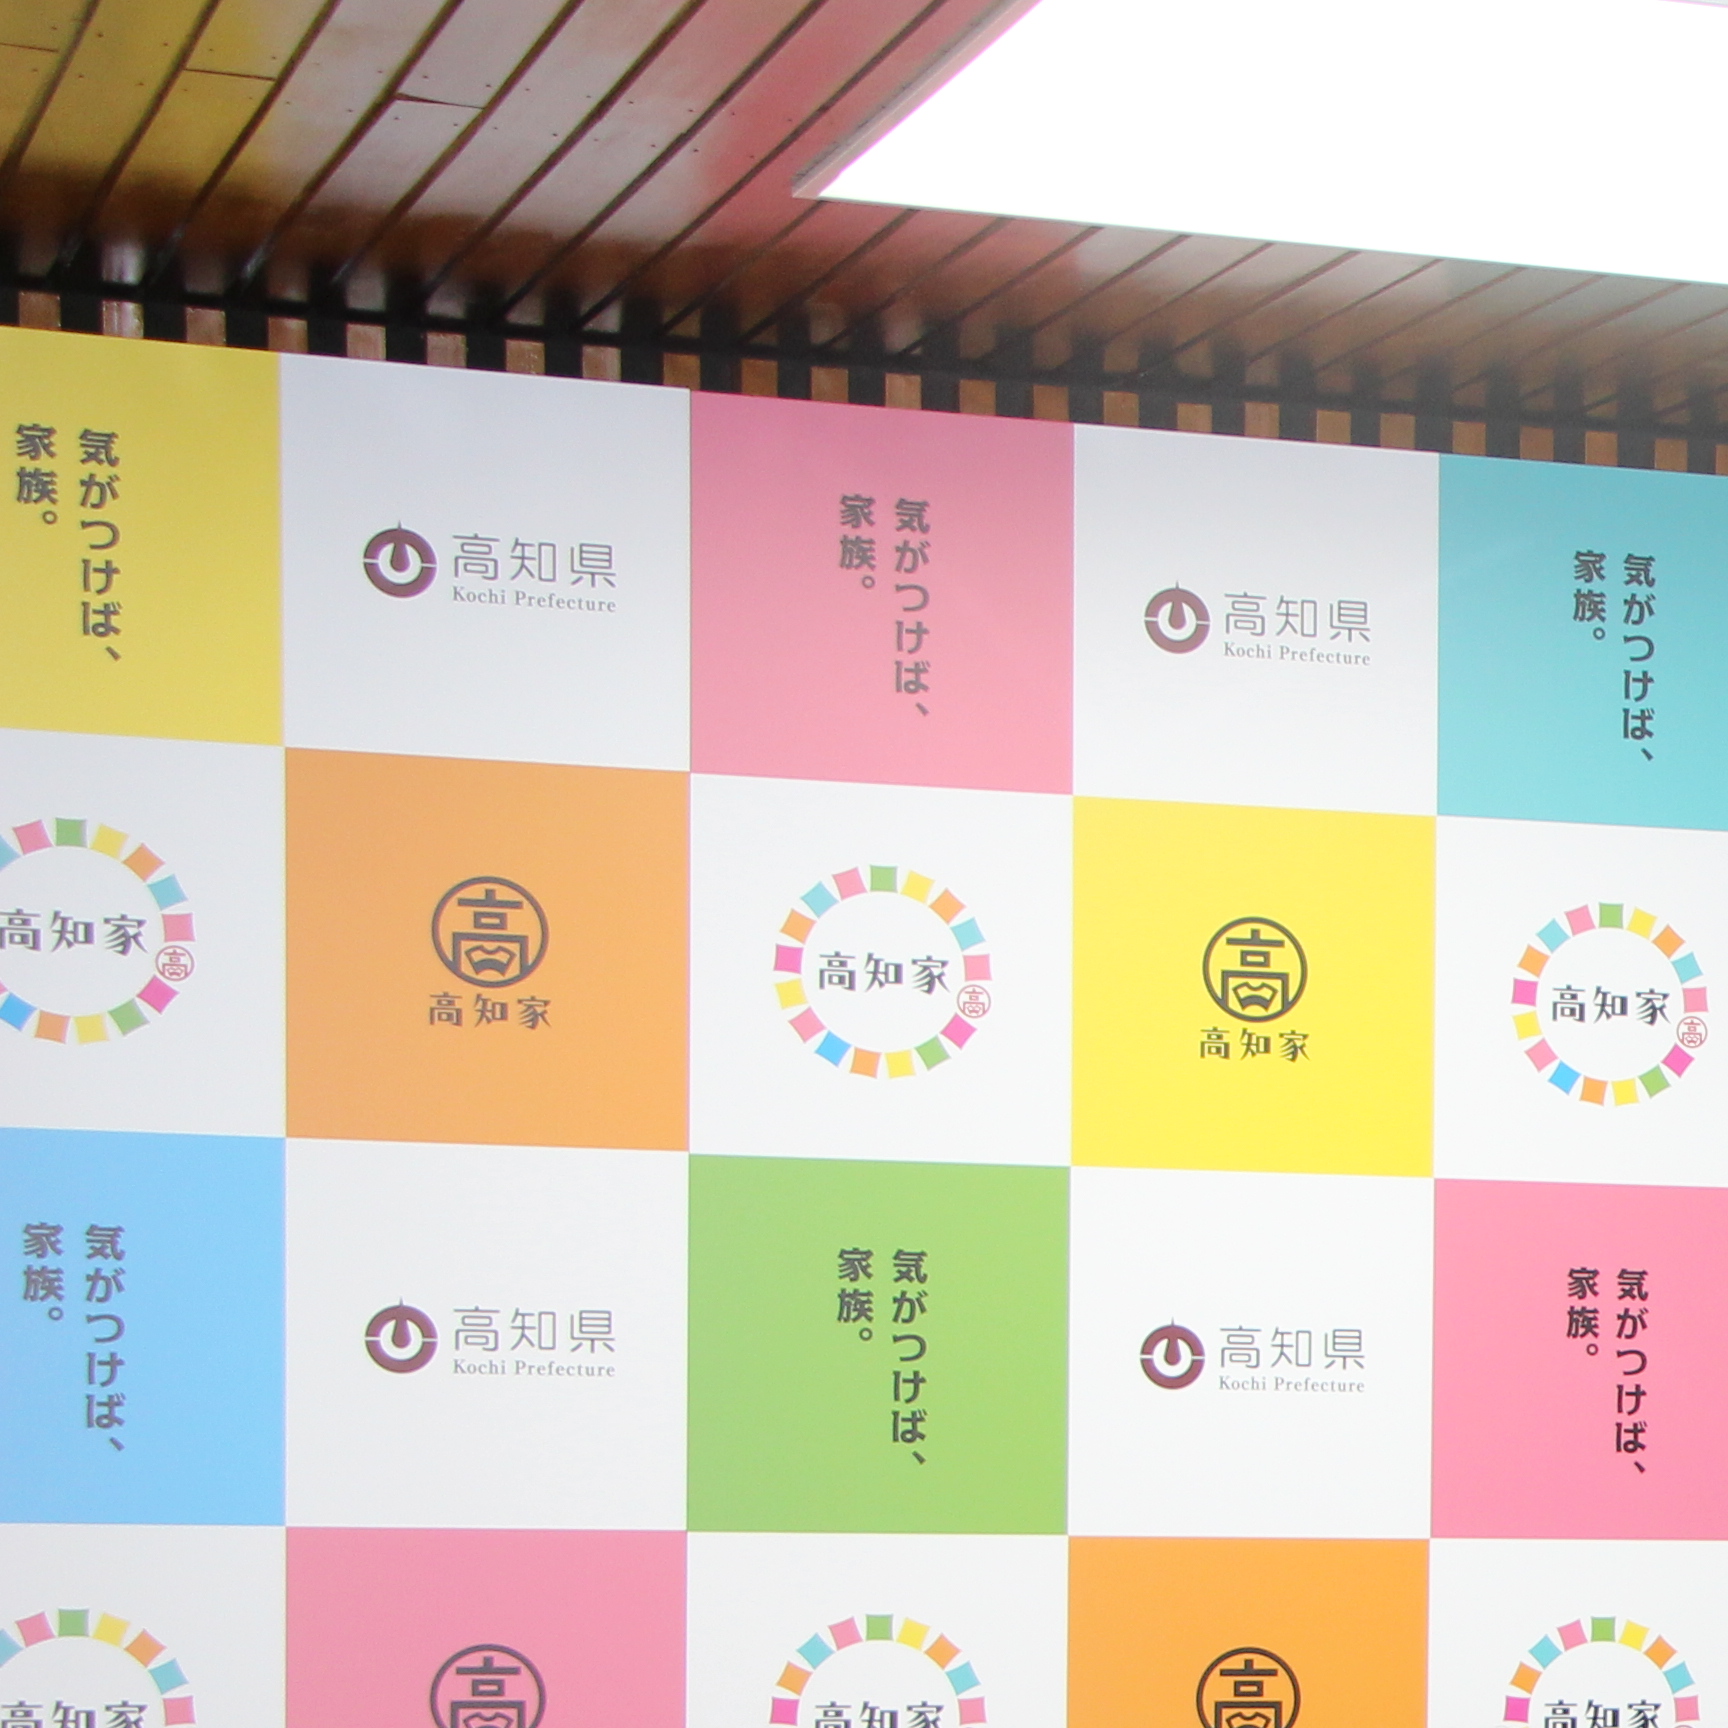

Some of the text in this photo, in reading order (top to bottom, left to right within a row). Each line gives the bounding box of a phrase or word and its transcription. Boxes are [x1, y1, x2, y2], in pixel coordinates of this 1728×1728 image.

[14, 422, 58, 526] 家族。
[77, 427, 122, 661] 気がつけば、
[451, 532, 617, 588] 高知県
[839, 493, 876, 589] 家族。
[452, 585, 616, 613] Kochi Prefecture
[893, 496, 932, 716] 気がつけば、
[1223, 591, 1371, 643] 高知県
[1572, 549, 1607, 641] 家族。
[1223, 641, 1371, 666] Kochi Prefecture
[1622, 552, 1657, 761] 気がつけば、
[0, 908, 147, 957] 高知家
[448, 886, 530, 980] 高
[818, 950, 949, 995] 高知家
[1217, 927, 1291, 1015] 高
[428, 991, 551, 1030] 高知家
[1200, 1026, 1310, 1063] 高知家
[1552, 984, 1670, 1027] 高知家
[21, 1221, 65, 1321] 家族。
[836, 1247, 874, 1342] 家族。
[1566, 1266, 1600, 1357] 家族。
[84, 1223, 126, 1452] 気がつけば、
[452, 1305, 616, 1354] 高知県
[452, 1358, 616, 1378] Kochi Prefecture
[891, 1248, 929, 1465] 気がつけば、
[1219, 1325, 1365, 1371] 高知県
[1615, 1268, 1649, 1474] 気がつけば、
[1218, 1375, 1365, 1393] Kochi Prefecture
